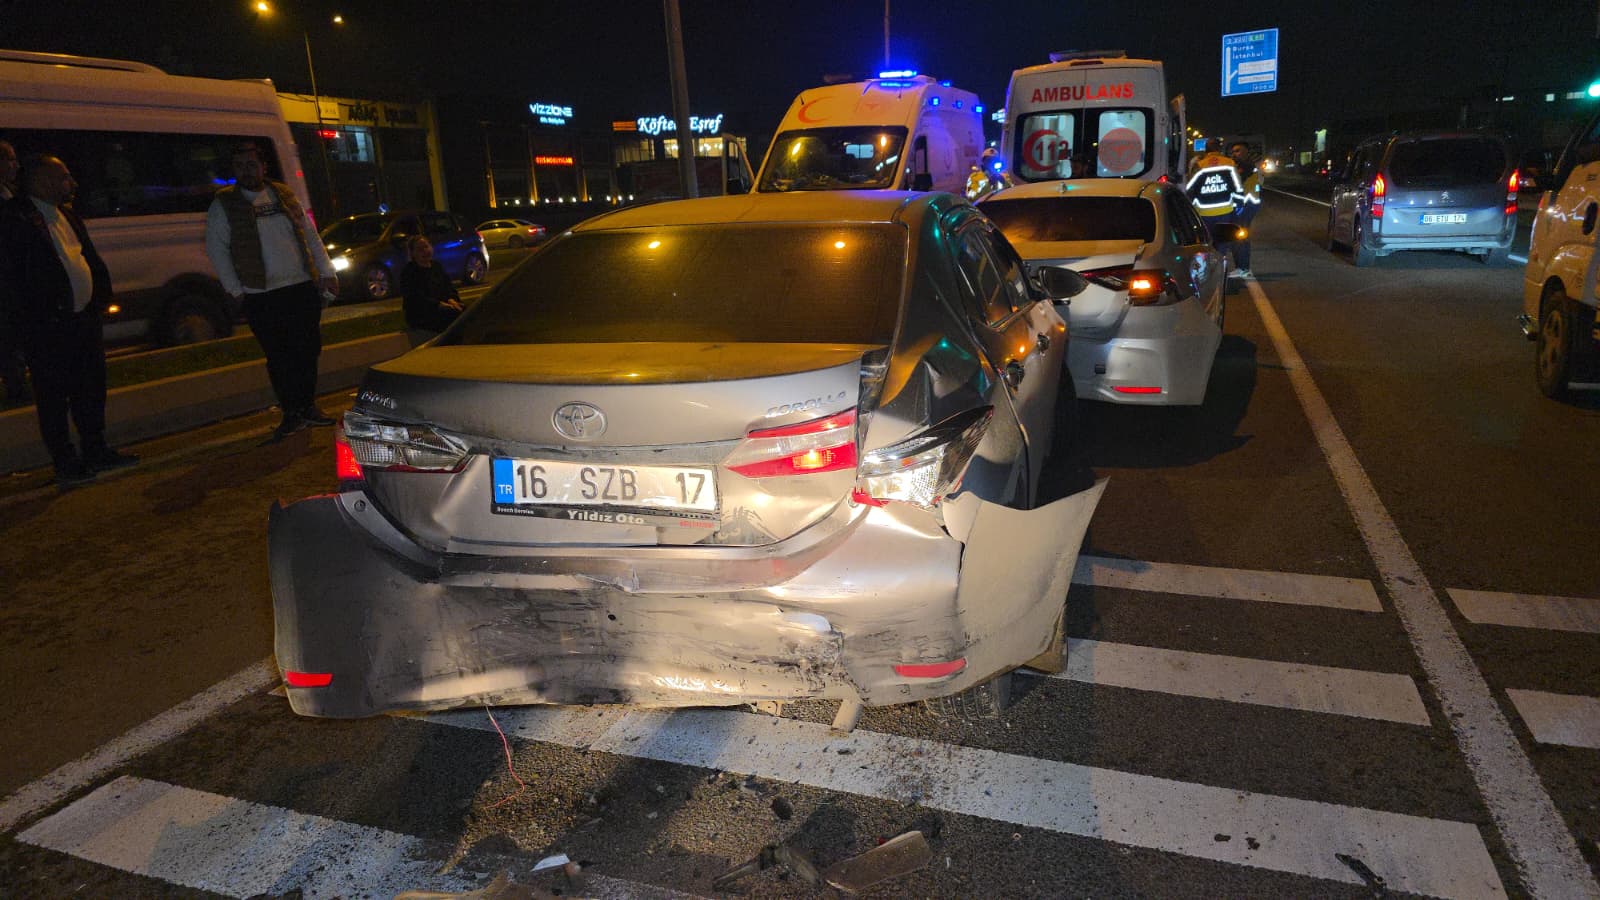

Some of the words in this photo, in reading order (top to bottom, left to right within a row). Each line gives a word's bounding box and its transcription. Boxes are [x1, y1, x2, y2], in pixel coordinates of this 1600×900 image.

[1031, 82, 1135, 103] AMBULANS
[1036, 140, 1069, 162] 112
[1201, 183, 1228, 194] SAĞLIK
[766, 391, 846, 418] COROLLA
[498, 484, 513, 495] TR
[516, 464, 548, 499] 16
[580, 466, 638, 501] SZB
[675, 472, 706, 505] 17
[566, 509, 612, 524] Yıldız
[615, 513, 645, 525] Oto
